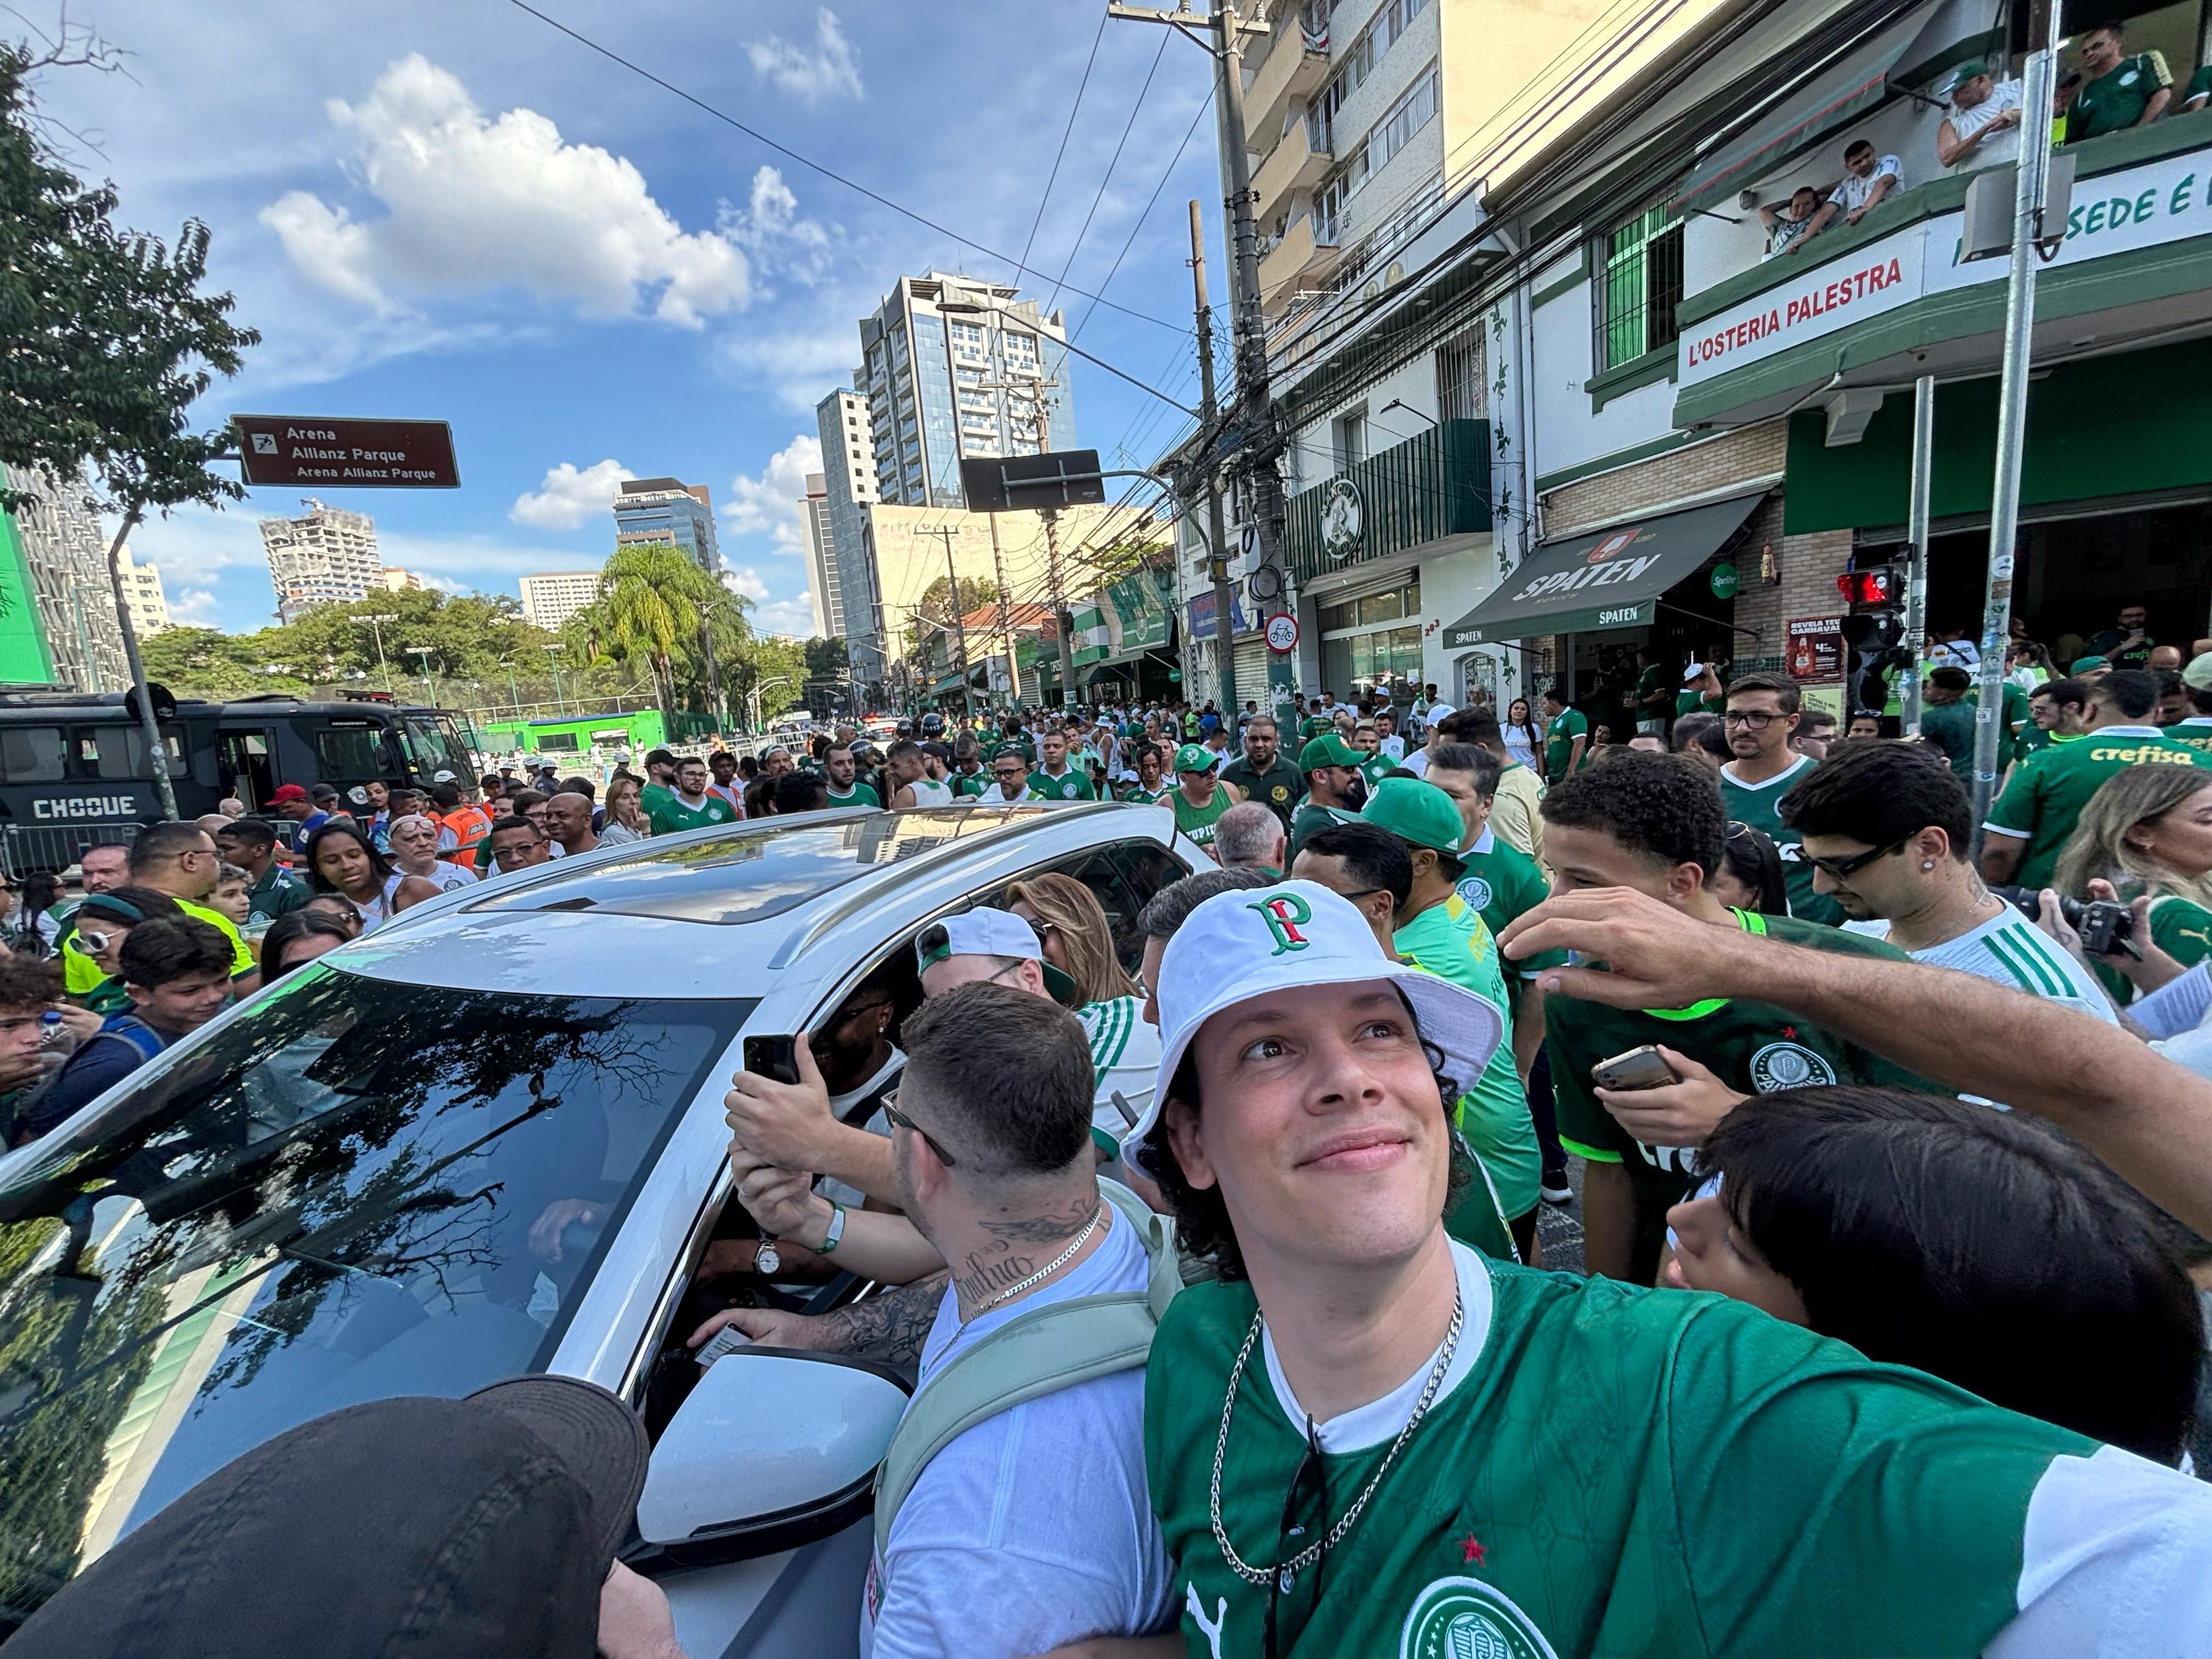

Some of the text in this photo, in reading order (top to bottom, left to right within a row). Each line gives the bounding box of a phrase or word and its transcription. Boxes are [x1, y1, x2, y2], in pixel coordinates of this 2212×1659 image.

[2065, 189, 2157, 240] SEDE
[1689, 258, 1902, 367] L'OSTERIA PALESTRA
[287, 427, 336, 440] Arena
[292, 447, 405, 463] Allianz Parque
[297, 467, 436, 480] Arena Allianz Parque
[1321, 483, 1358, 518] MANCHA
[1512, 554, 1662, 601] SPATEN
[1713, 575, 1736, 587] Sprite
[1599, 607, 1637, 625] SPATEN
[1791, 620, 1823, 629] REVELA
[1425, 619, 1440, 636] 203
[1455, 630, 1482, 644] SPATEN
[2124, 648, 2151, 660] crefi
[2090, 746, 2194, 765] crefisa
[33, 796, 137, 819] CHOQUE
